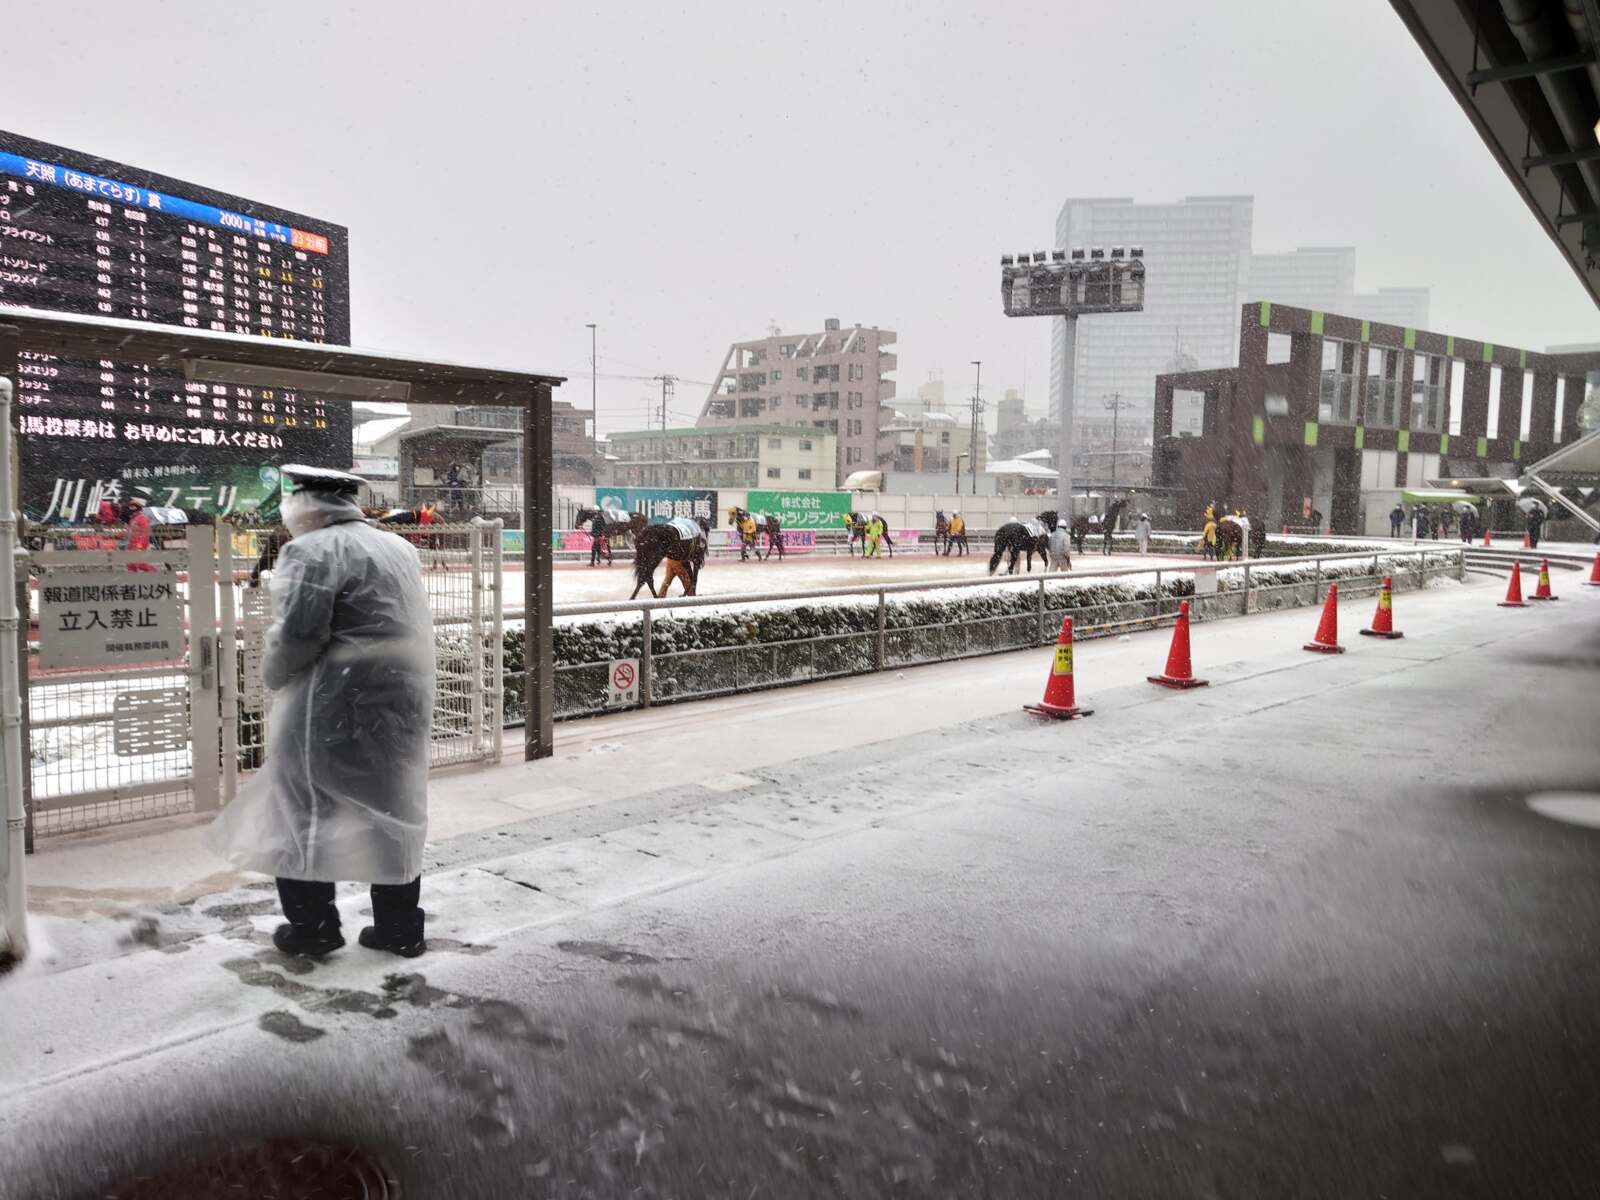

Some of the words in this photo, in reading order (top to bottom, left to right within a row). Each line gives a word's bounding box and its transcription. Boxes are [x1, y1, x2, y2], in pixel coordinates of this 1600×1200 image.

[124, 422, 283, 449] お早めにご購入ください
[636, 499, 712, 520] 川崎競馬
[781, 496, 821, 509] 株式会社
[44, 583, 173, 604] 報道関係者以外
[58, 608, 158, 632] 立入禁止
